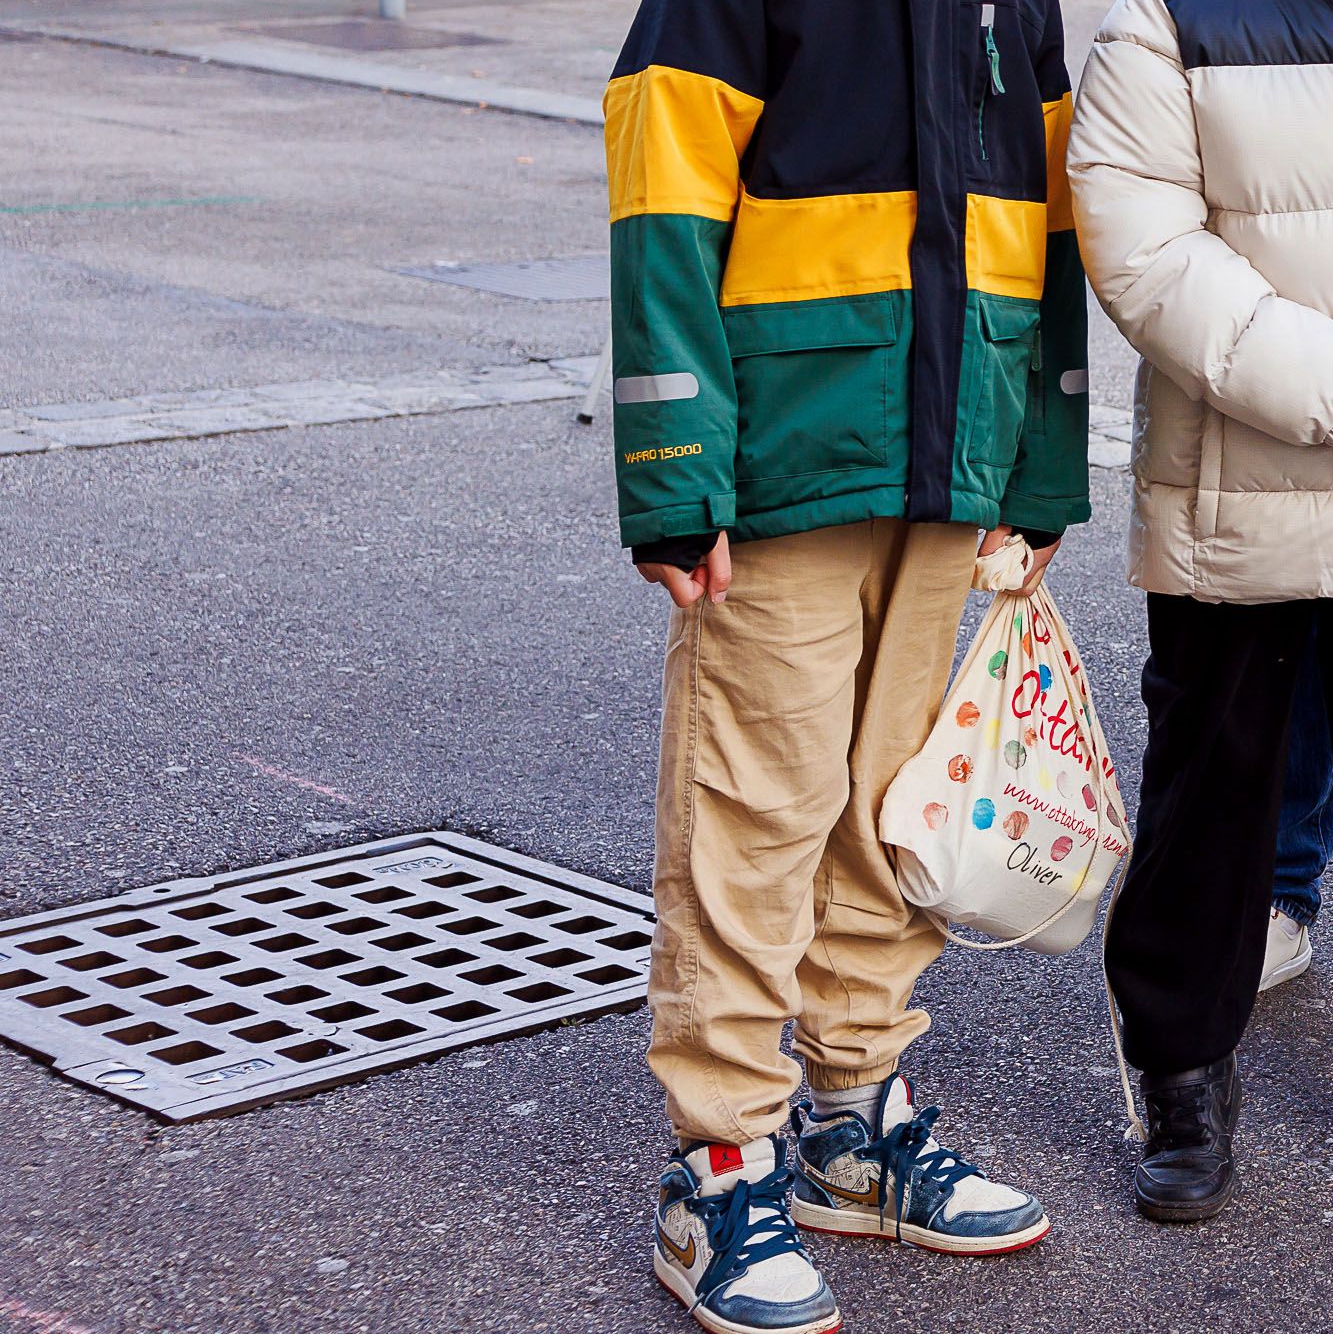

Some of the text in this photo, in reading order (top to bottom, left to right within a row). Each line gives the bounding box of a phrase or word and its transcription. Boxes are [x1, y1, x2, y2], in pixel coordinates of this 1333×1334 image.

[624, 443, 702, 464] W-PRO 15000
[1007, 842, 1063, 886] Oliver
